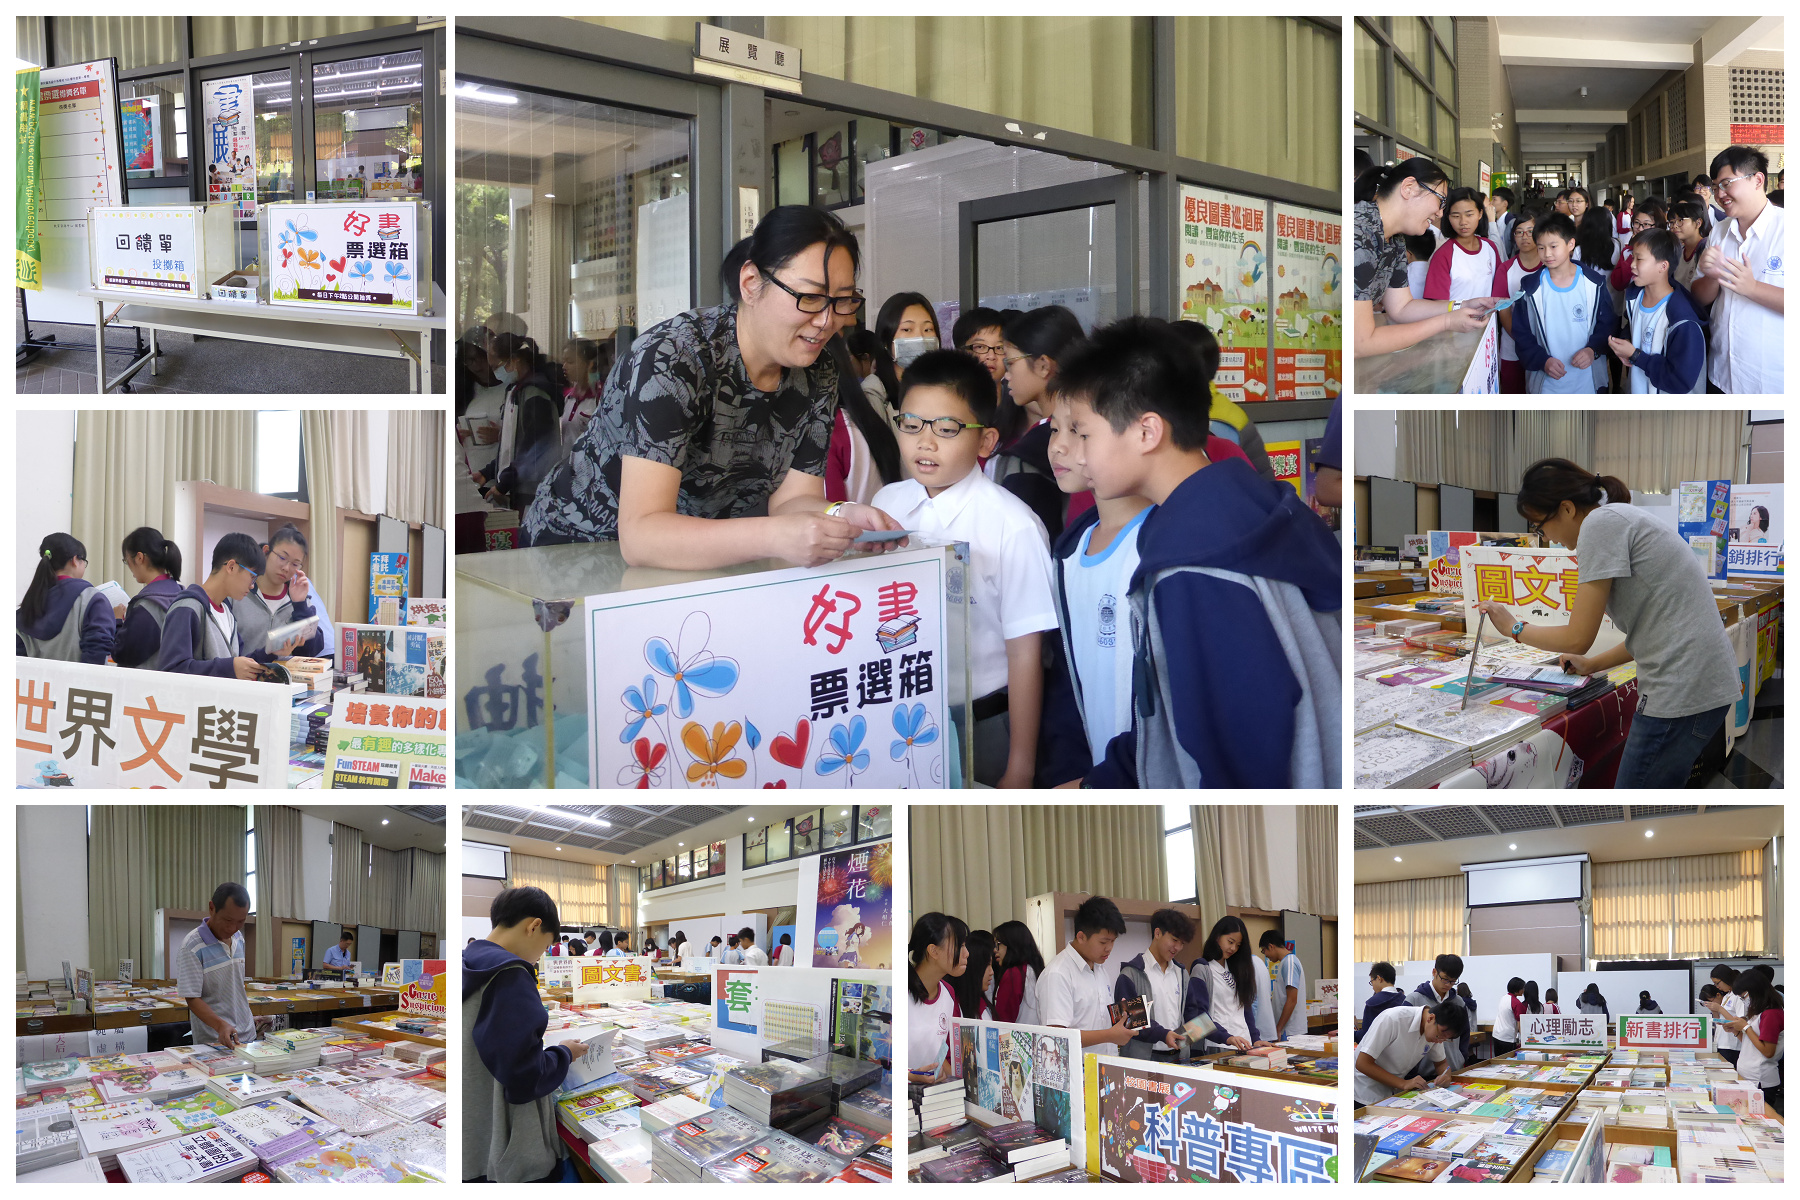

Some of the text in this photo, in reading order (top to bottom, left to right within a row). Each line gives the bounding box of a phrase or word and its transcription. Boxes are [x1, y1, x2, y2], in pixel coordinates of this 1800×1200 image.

[719, 36, 784, 67] 展覽廳
[343, 210, 401, 237] 好書
[1184, 196, 1264, 233] 優良圖書巡迴展
[1276, 213, 1342, 245] 優良圖書巡迴展
[116, 233, 172, 253] 回饋單
[346, 241, 408, 260] 票選箱
[152, 259, 185, 271] 投擲箱
[1728, 548, 1781, 567] 銷排行
[802, 580, 918, 655] 好書
[810, 649, 934, 722] 票選箱
[16, 678, 260, 789] 世界文學
[336, 758, 380, 773] FunSTEAM
[410, 767, 446, 784] Make
[335, 772, 358, 784] STEAM
[847, 850, 869, 900] 煙花
[581, 963, 642, 986] 圖文書
[725, 980, 758, 1014] 套
[1530, 1017, 1595, 1036] 心理勵志
[1626, 1021, 1702, 1040] 新書排行
[1125, 1076, 1171, 1094] 校園書展
[1144, 1102, 1338, 1183] 科普專區
